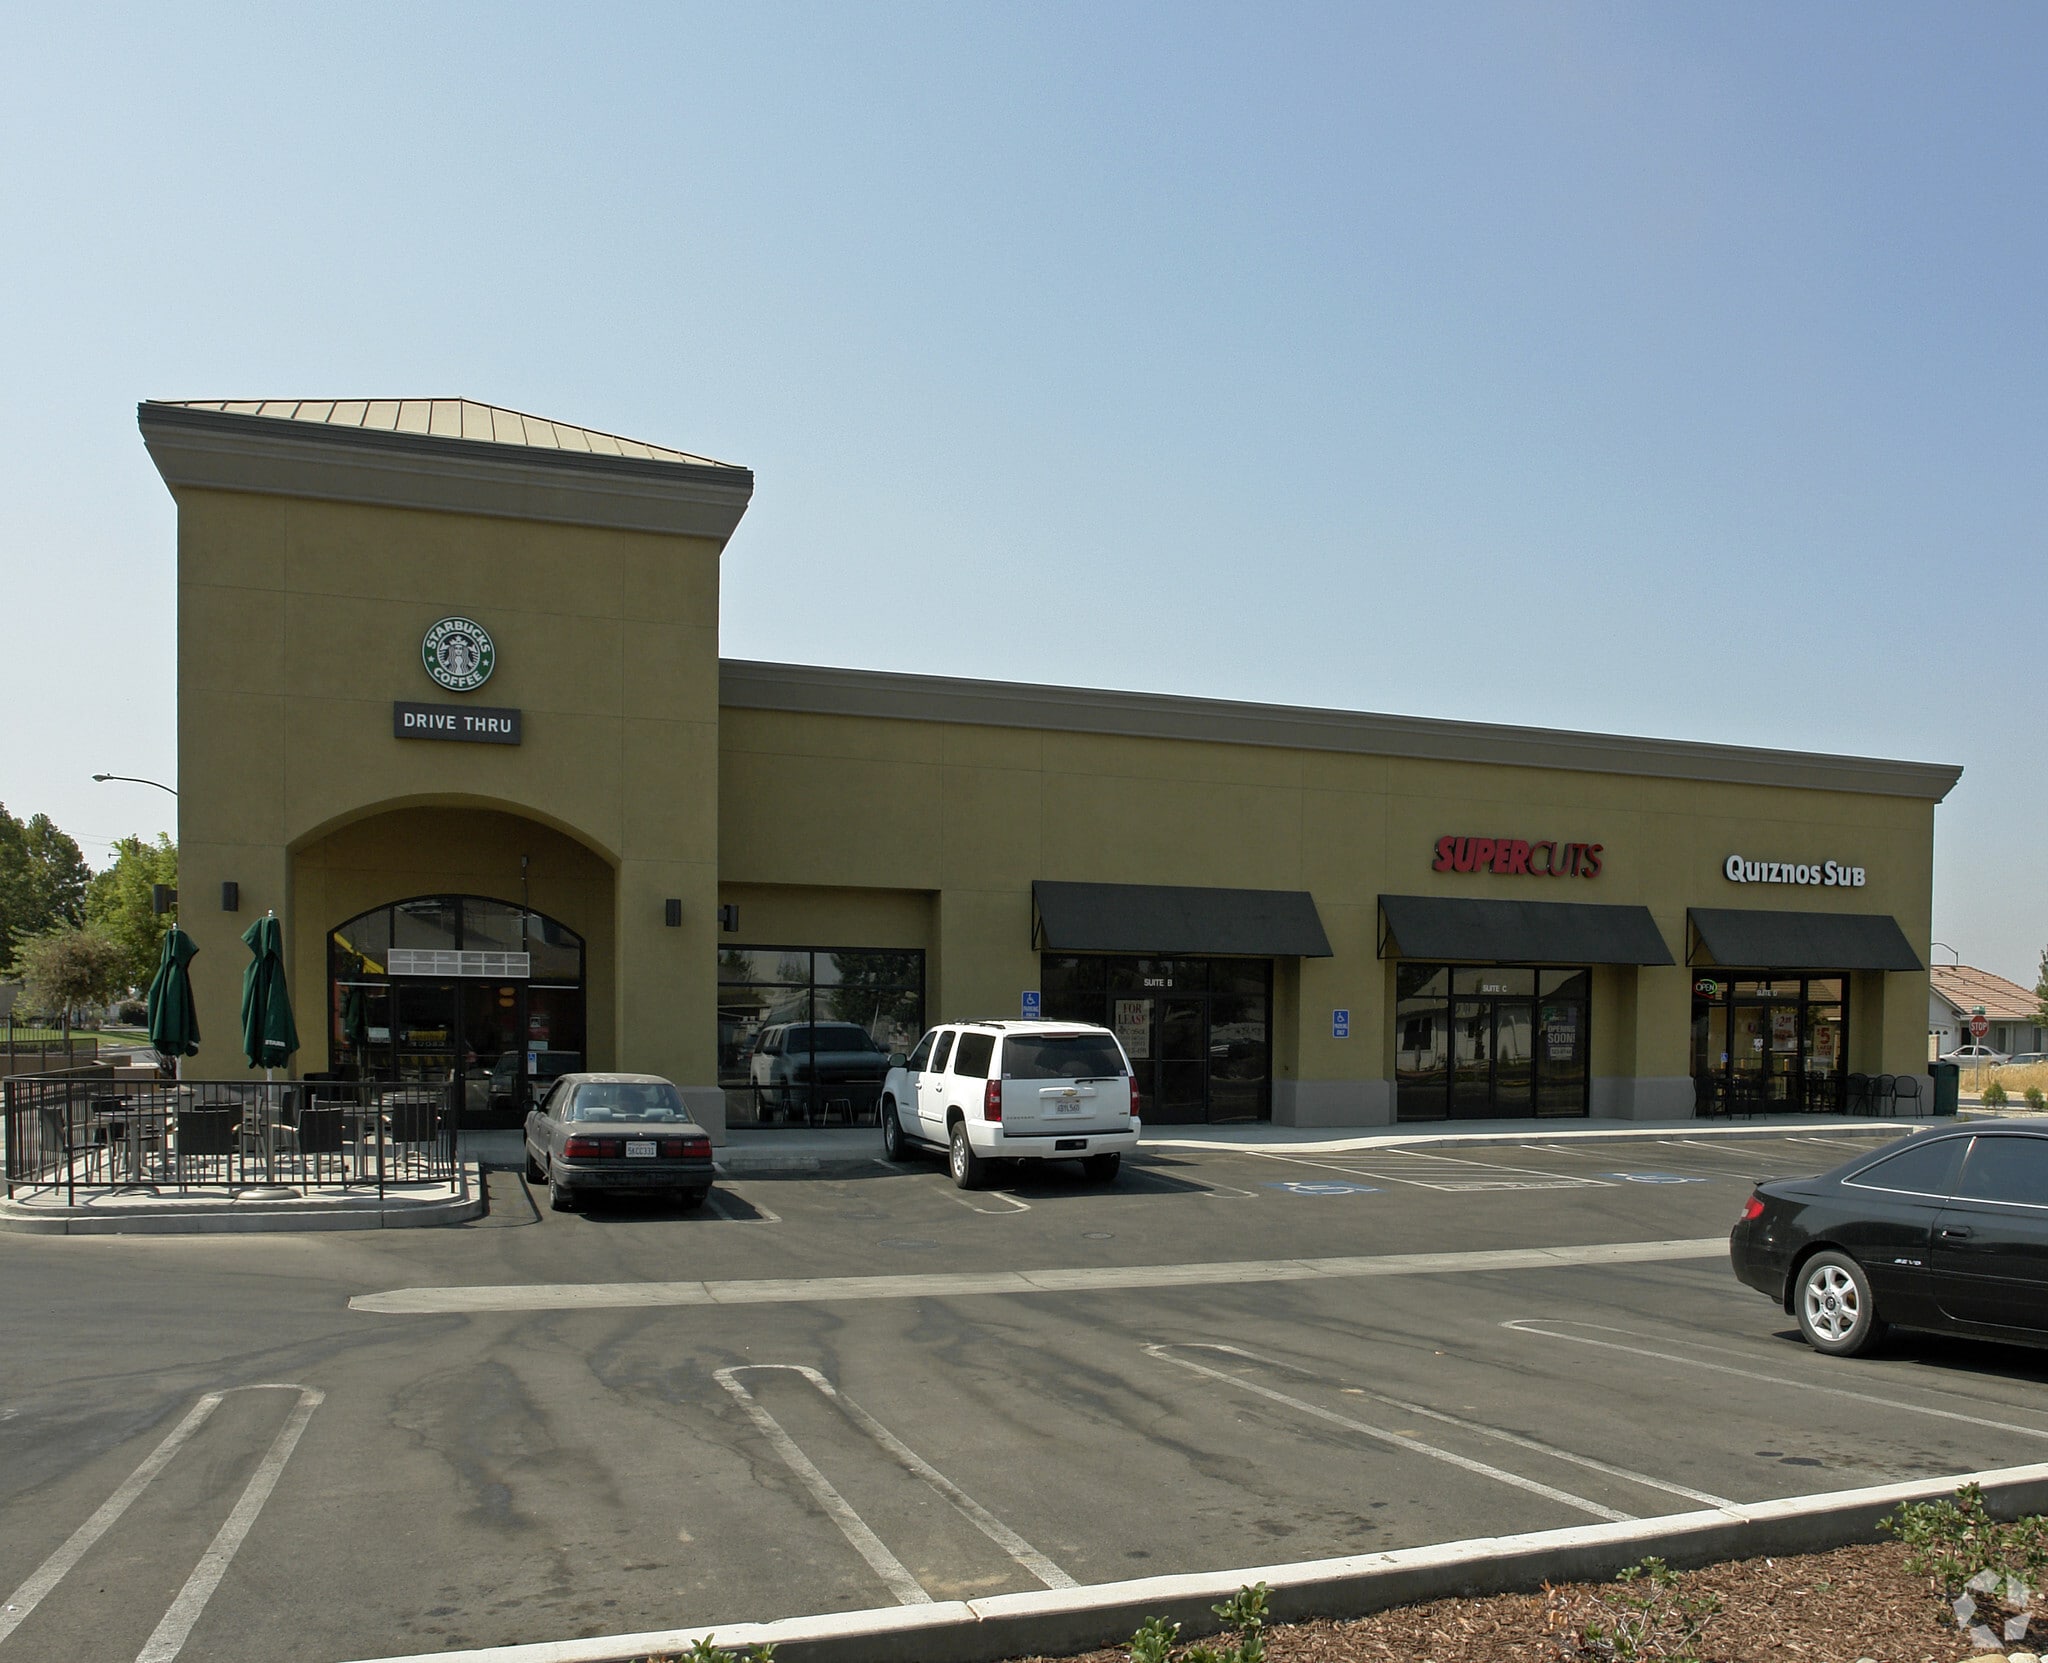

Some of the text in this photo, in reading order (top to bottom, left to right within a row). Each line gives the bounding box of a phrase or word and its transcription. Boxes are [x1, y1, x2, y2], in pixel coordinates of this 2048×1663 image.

[426, 620, 491, 653] STARBUCKS
[433, 666, 483, 687] COFFEE
[403, 713, 512, 733] DRIVE THRU
[1433, 835, 1604, 878] SUPERCUTS
[1144, 979, 1173, 987] SUITE B
[1482, 984, 1499, 992] SUITE
[1695, 983, 1715, 992] OPEN
[1123, 1003, 1142, 1014] FOR
[1118, 1014, 1146, 1025] LEASE
[1547, 1025, 1576, 1033] OPENING
[1971, 1022, 1988, 1031] STOP
[1547, 1033, 1576, 1044] SOON!
[1817, 1027, 1831, 1045] $5
